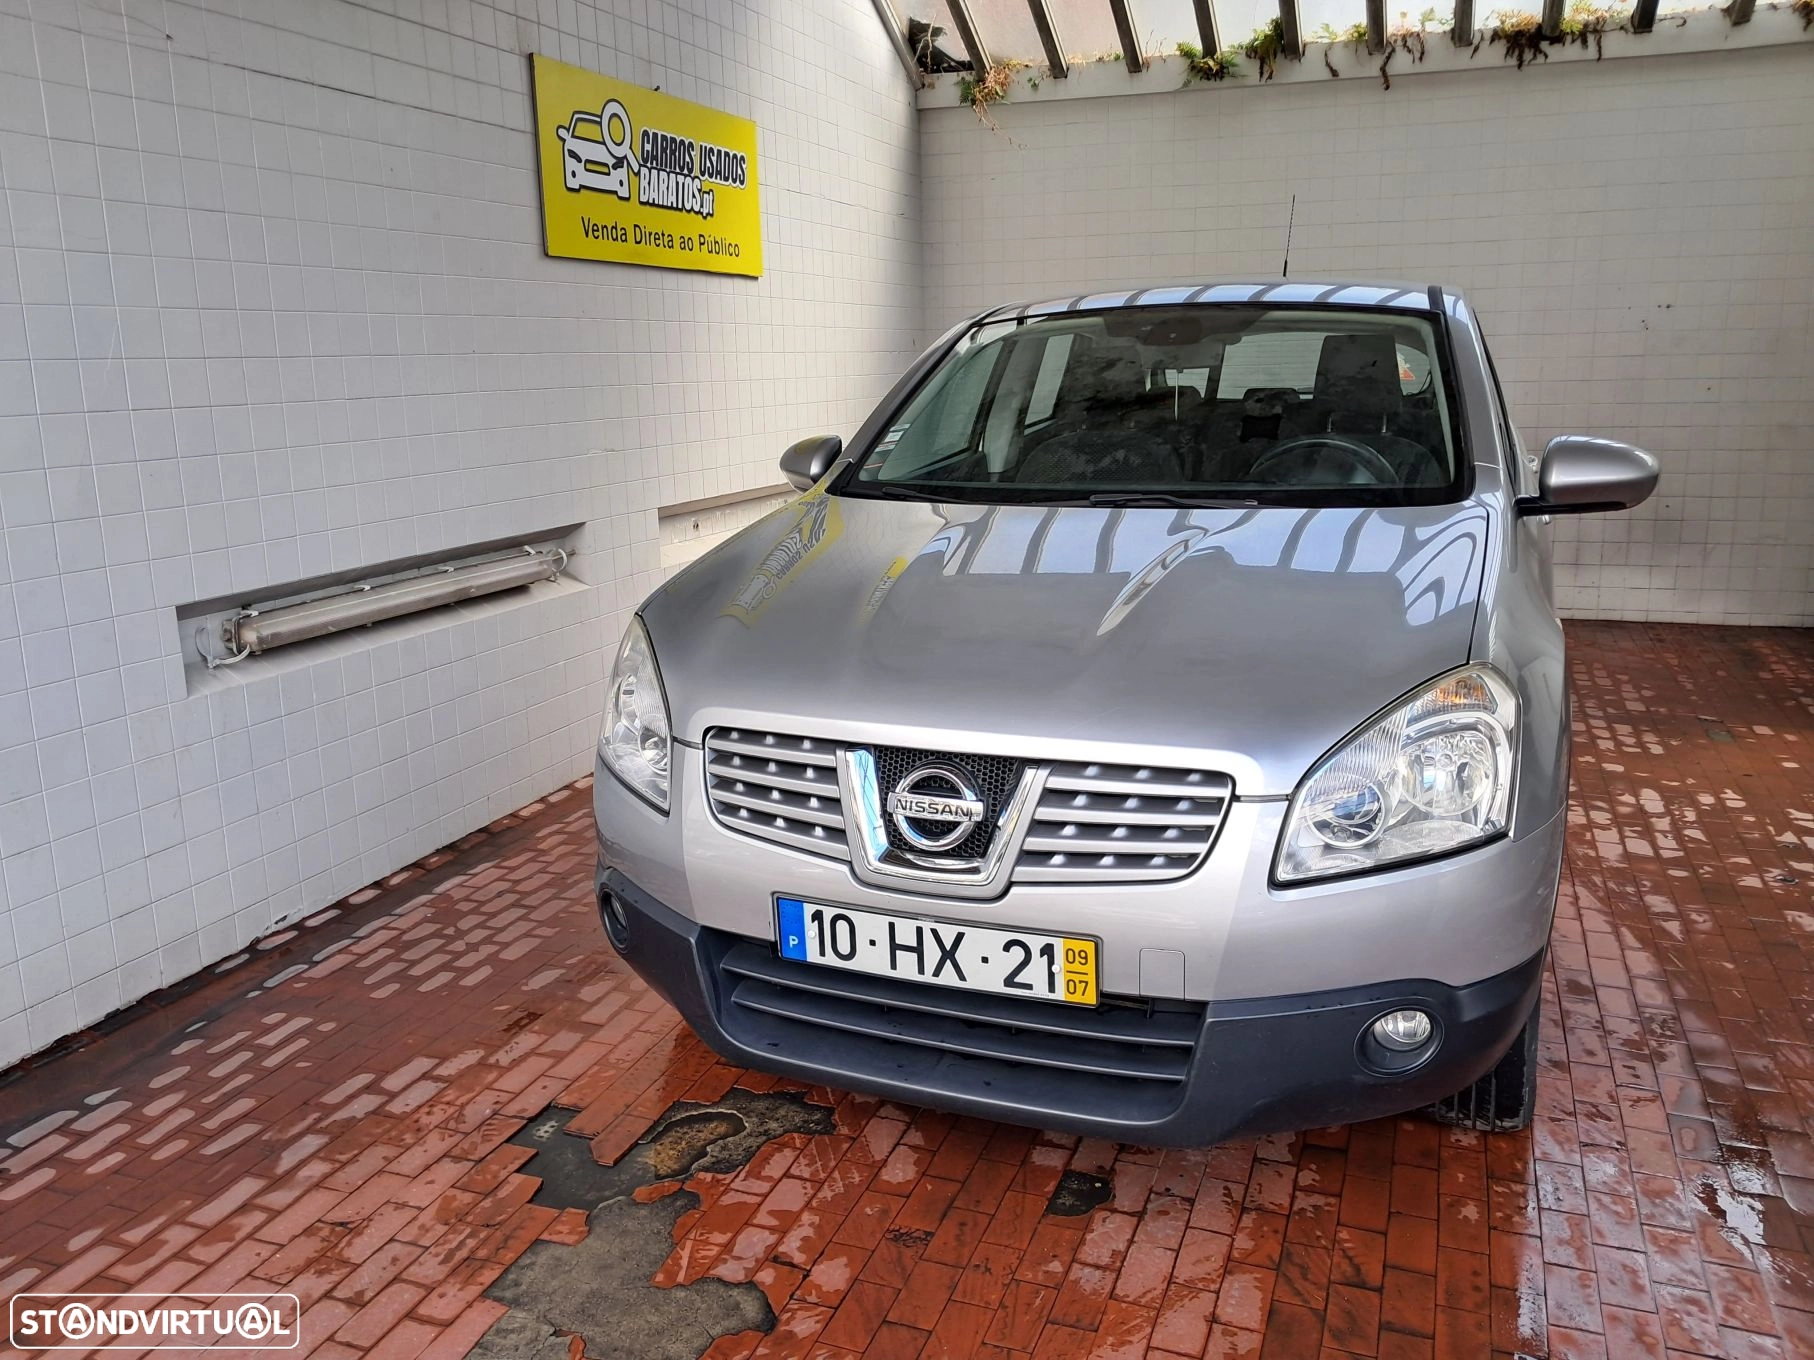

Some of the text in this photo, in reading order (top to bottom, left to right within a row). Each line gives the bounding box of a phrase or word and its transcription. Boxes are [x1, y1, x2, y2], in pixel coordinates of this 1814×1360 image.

[640, 128, 746, 186] CARROS USADOS
[581, 216, 741, 258] Venda Direta ao Público
[895, 798, 970, 818] NISSAN
[789, 935, 799, 949] P
[1065, 948, 1089, 966] 09
[1066, 979, 1089, 997] 07
